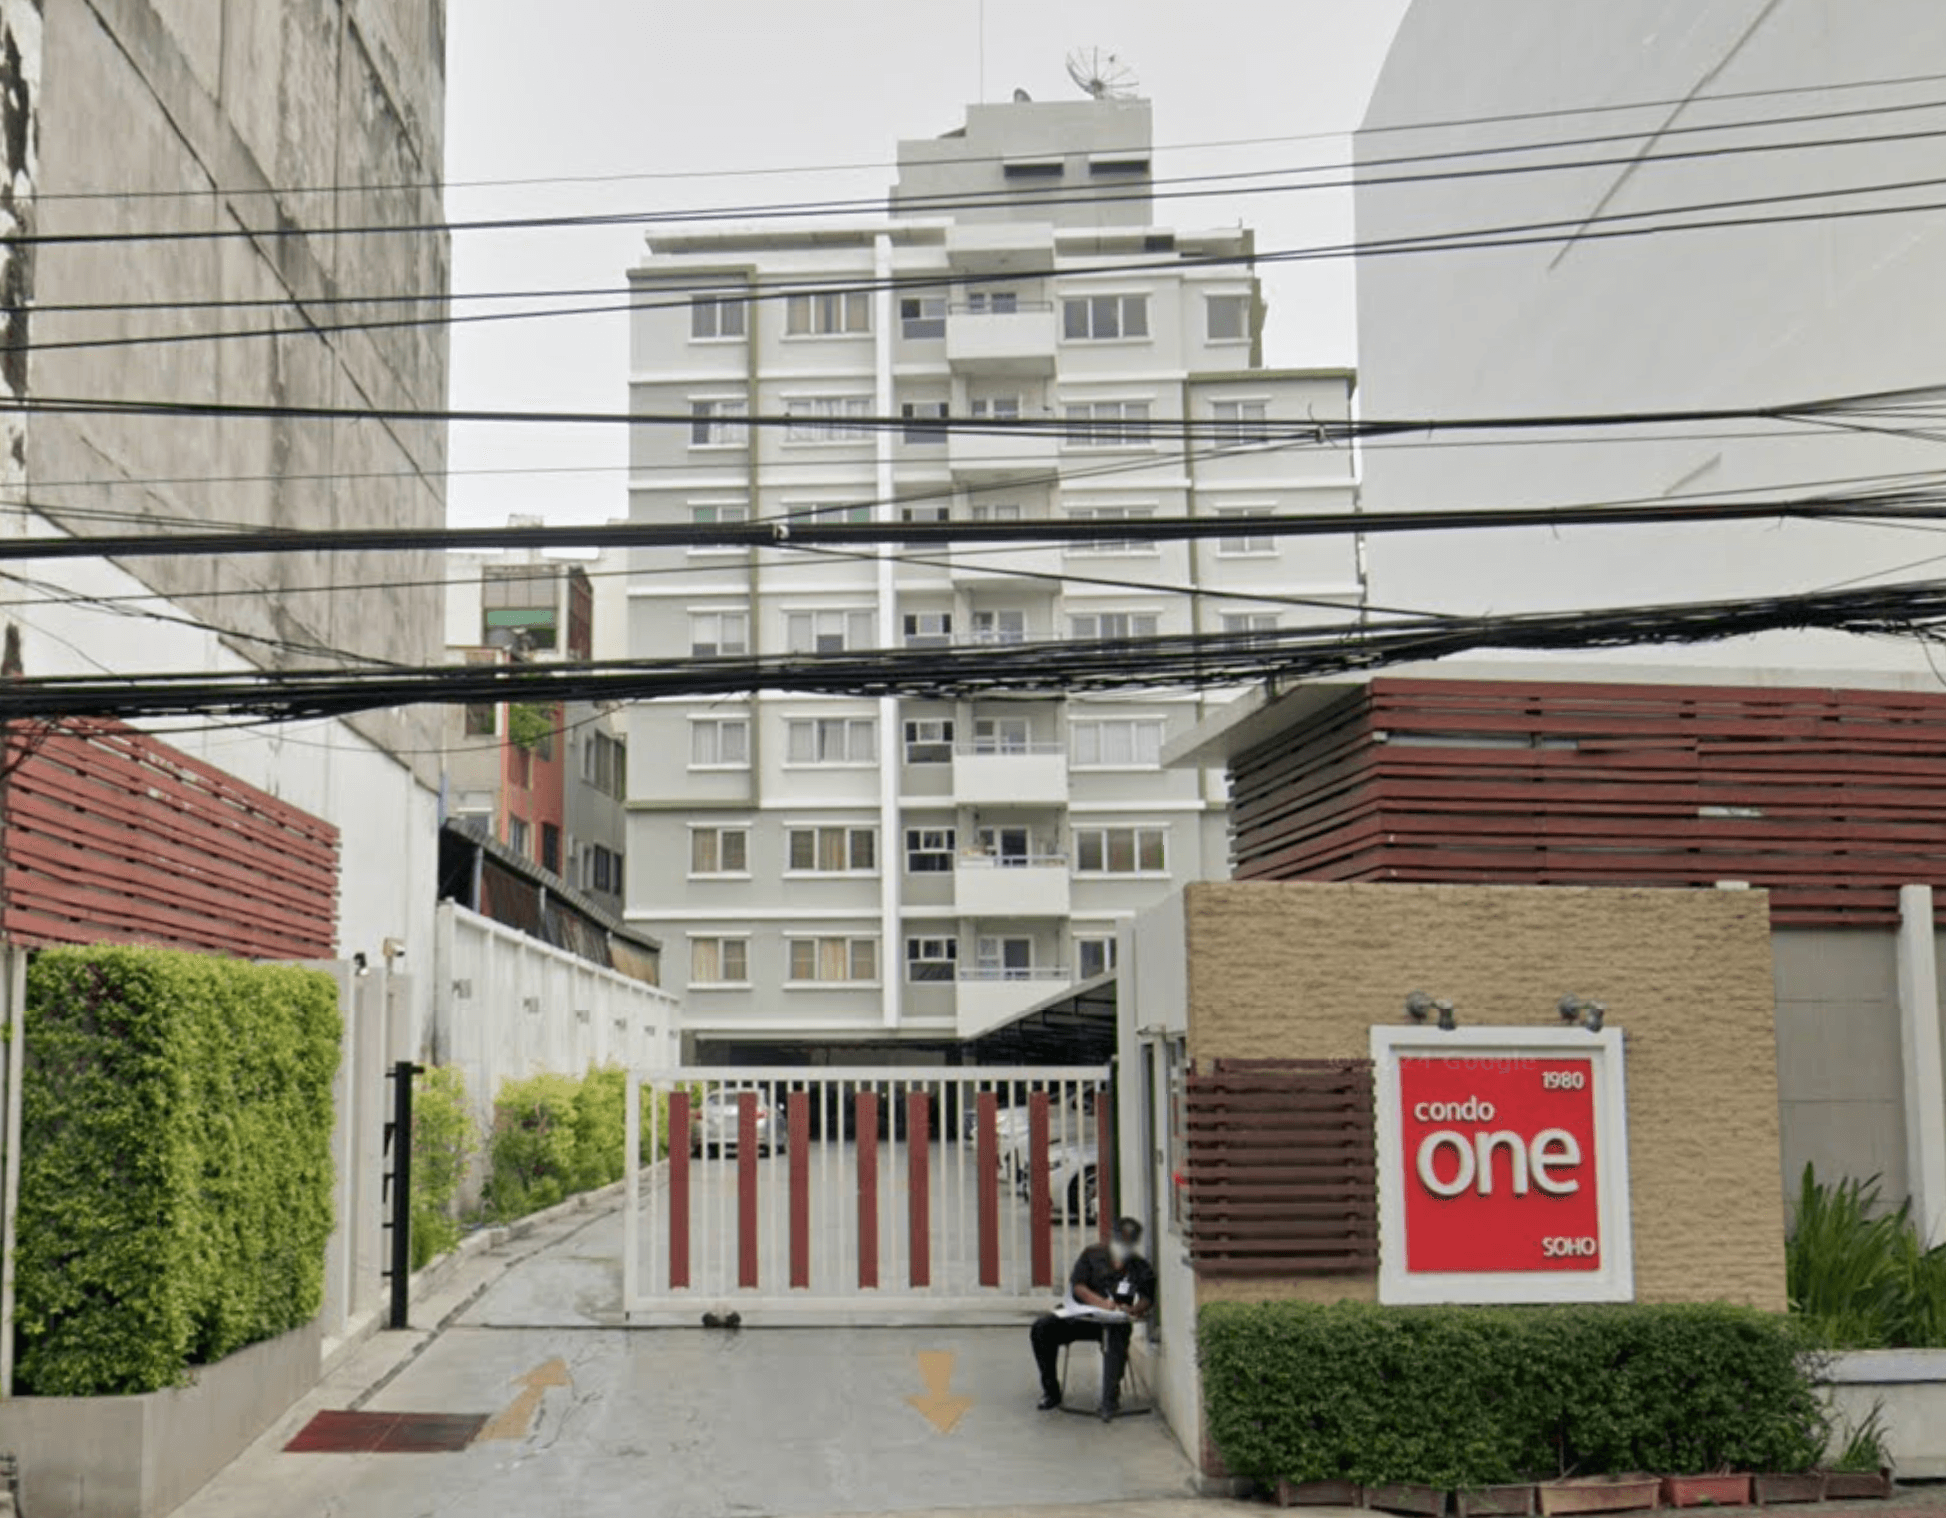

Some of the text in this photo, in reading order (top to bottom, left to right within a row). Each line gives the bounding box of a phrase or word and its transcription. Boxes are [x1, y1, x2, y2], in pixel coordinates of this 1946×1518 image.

[1541, 1070, 1586, 1090] 1980
[1413, 1094, 1496, 1123] condo
[1416, 1127, 1582, 1197] one
[1541, 1235, 1597, 1257] SOHO
